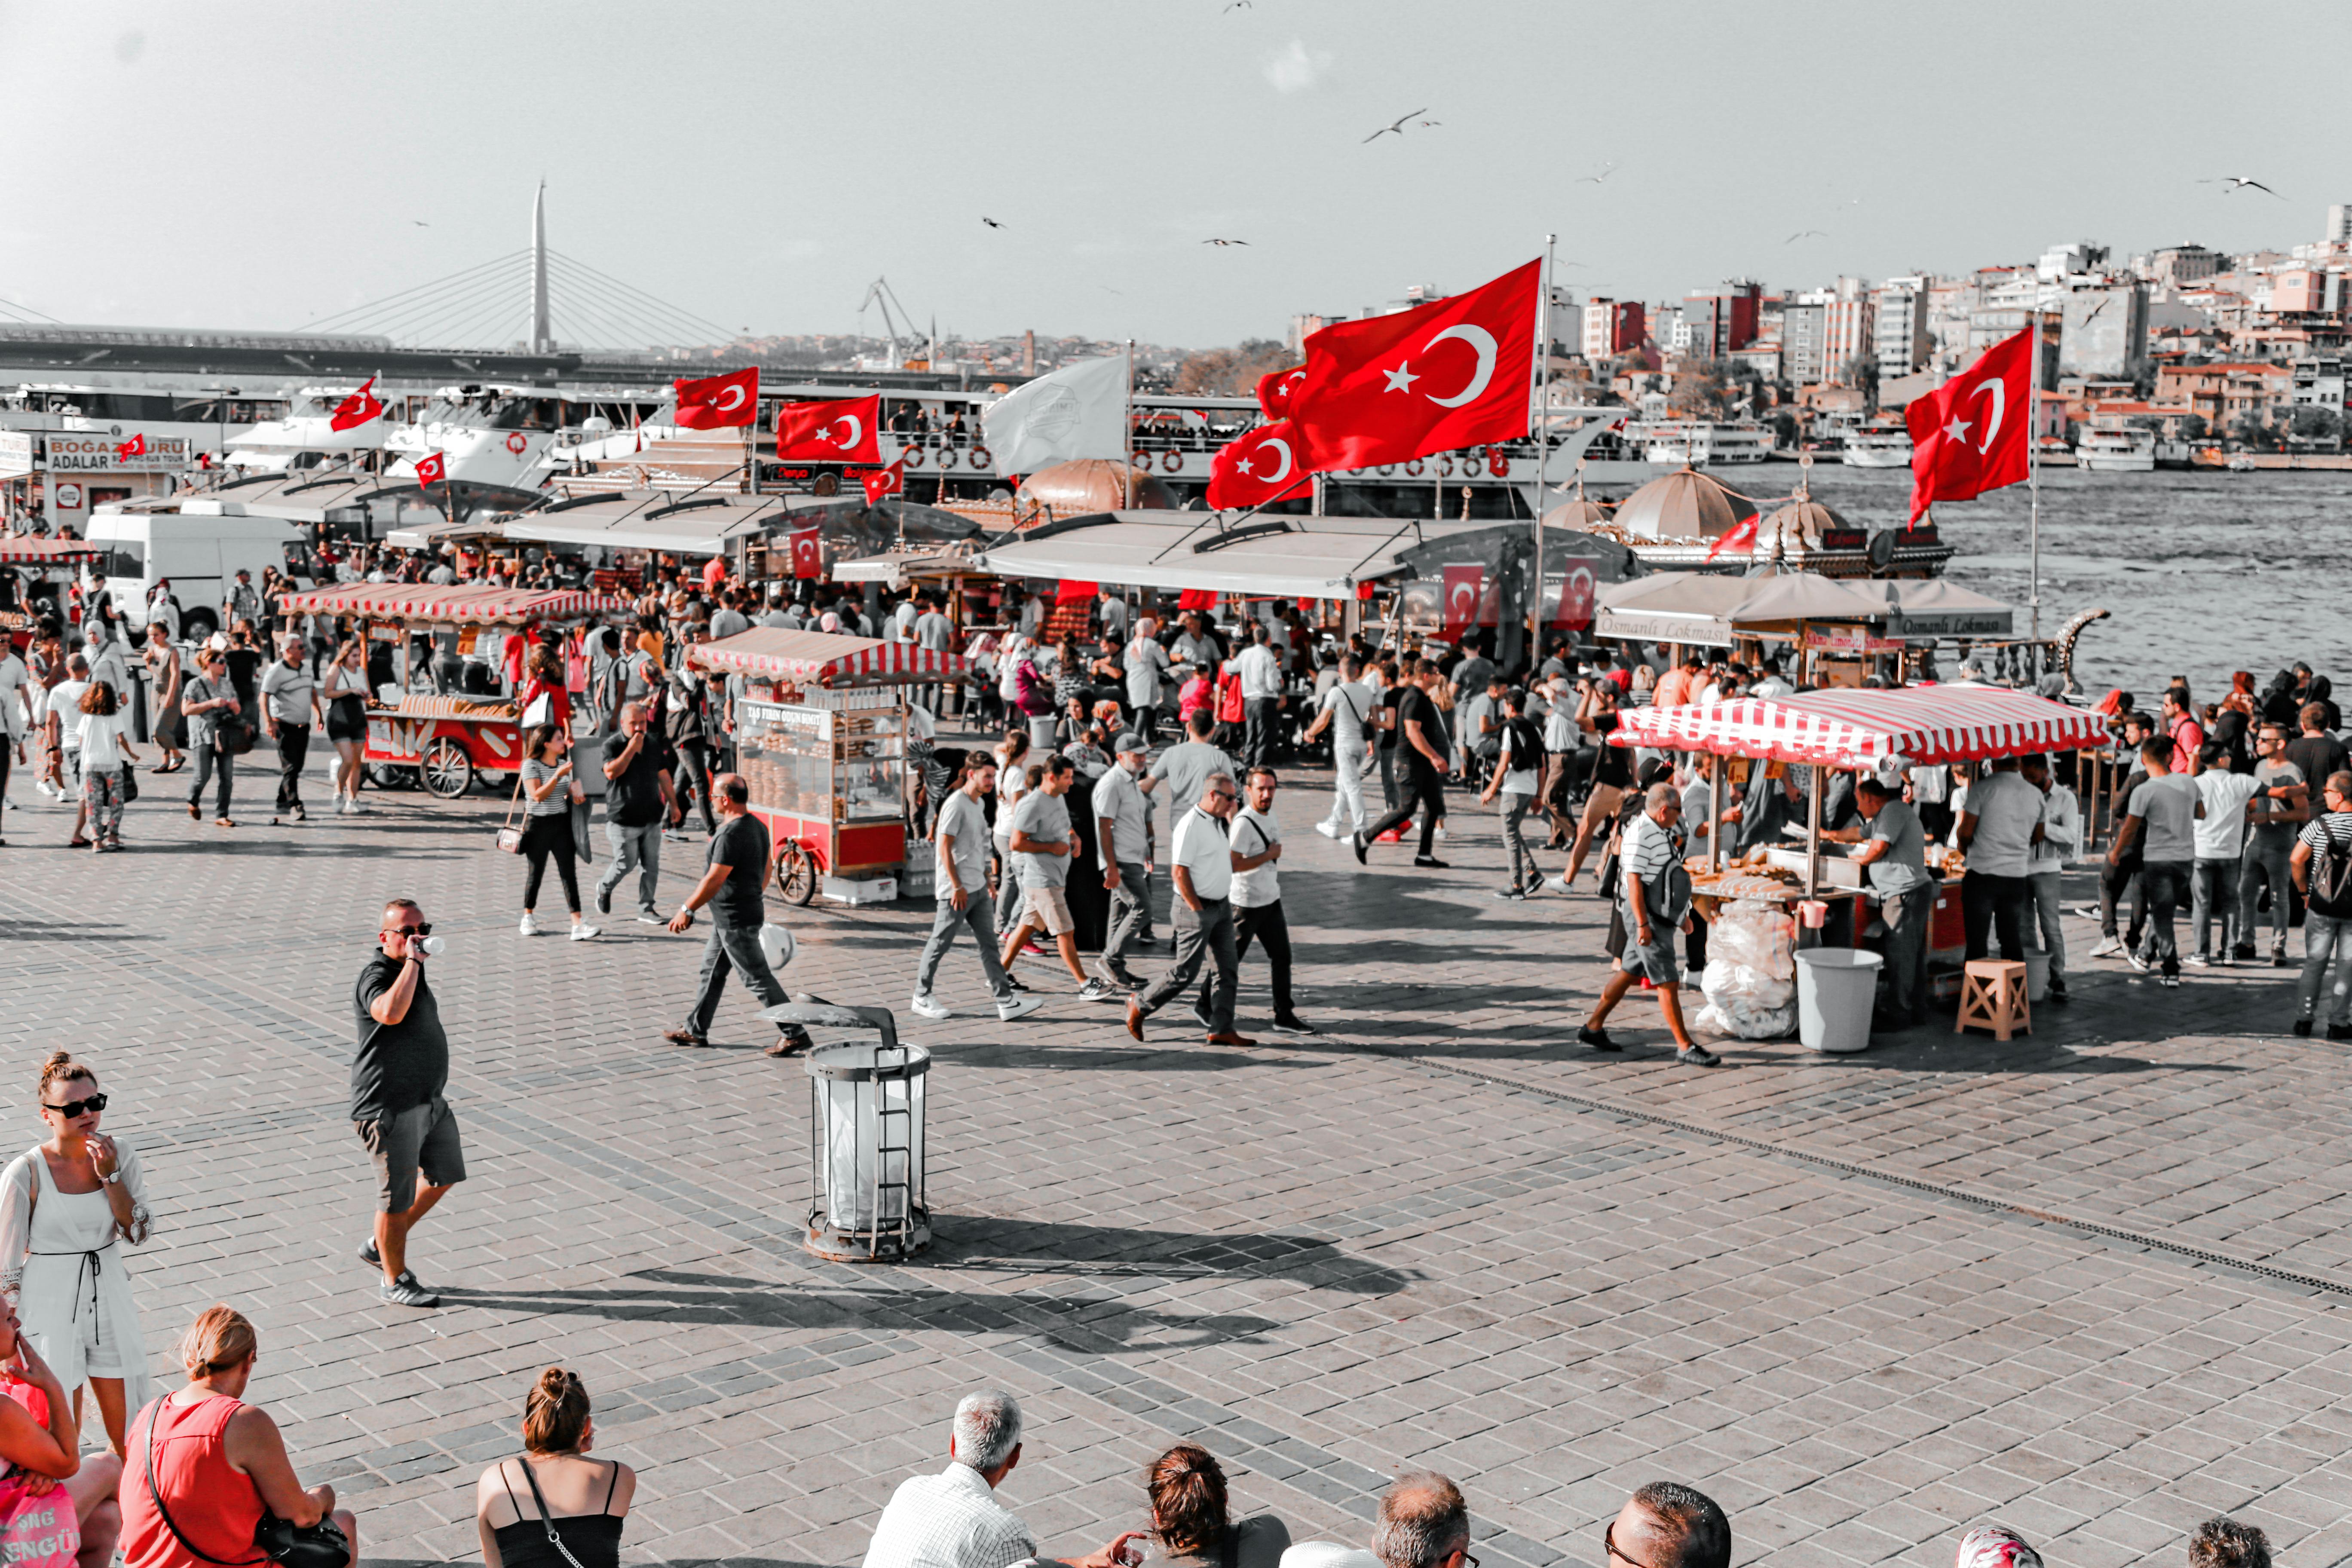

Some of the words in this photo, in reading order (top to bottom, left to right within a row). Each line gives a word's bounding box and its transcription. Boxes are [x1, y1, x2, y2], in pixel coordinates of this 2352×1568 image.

[144, 443, 184, 453] URU
[52, 455, 108, 469] ADALAR
[1602, 617, 1658, 636] Osmanlı
[1664, 622, 1724, 641] Lokması
